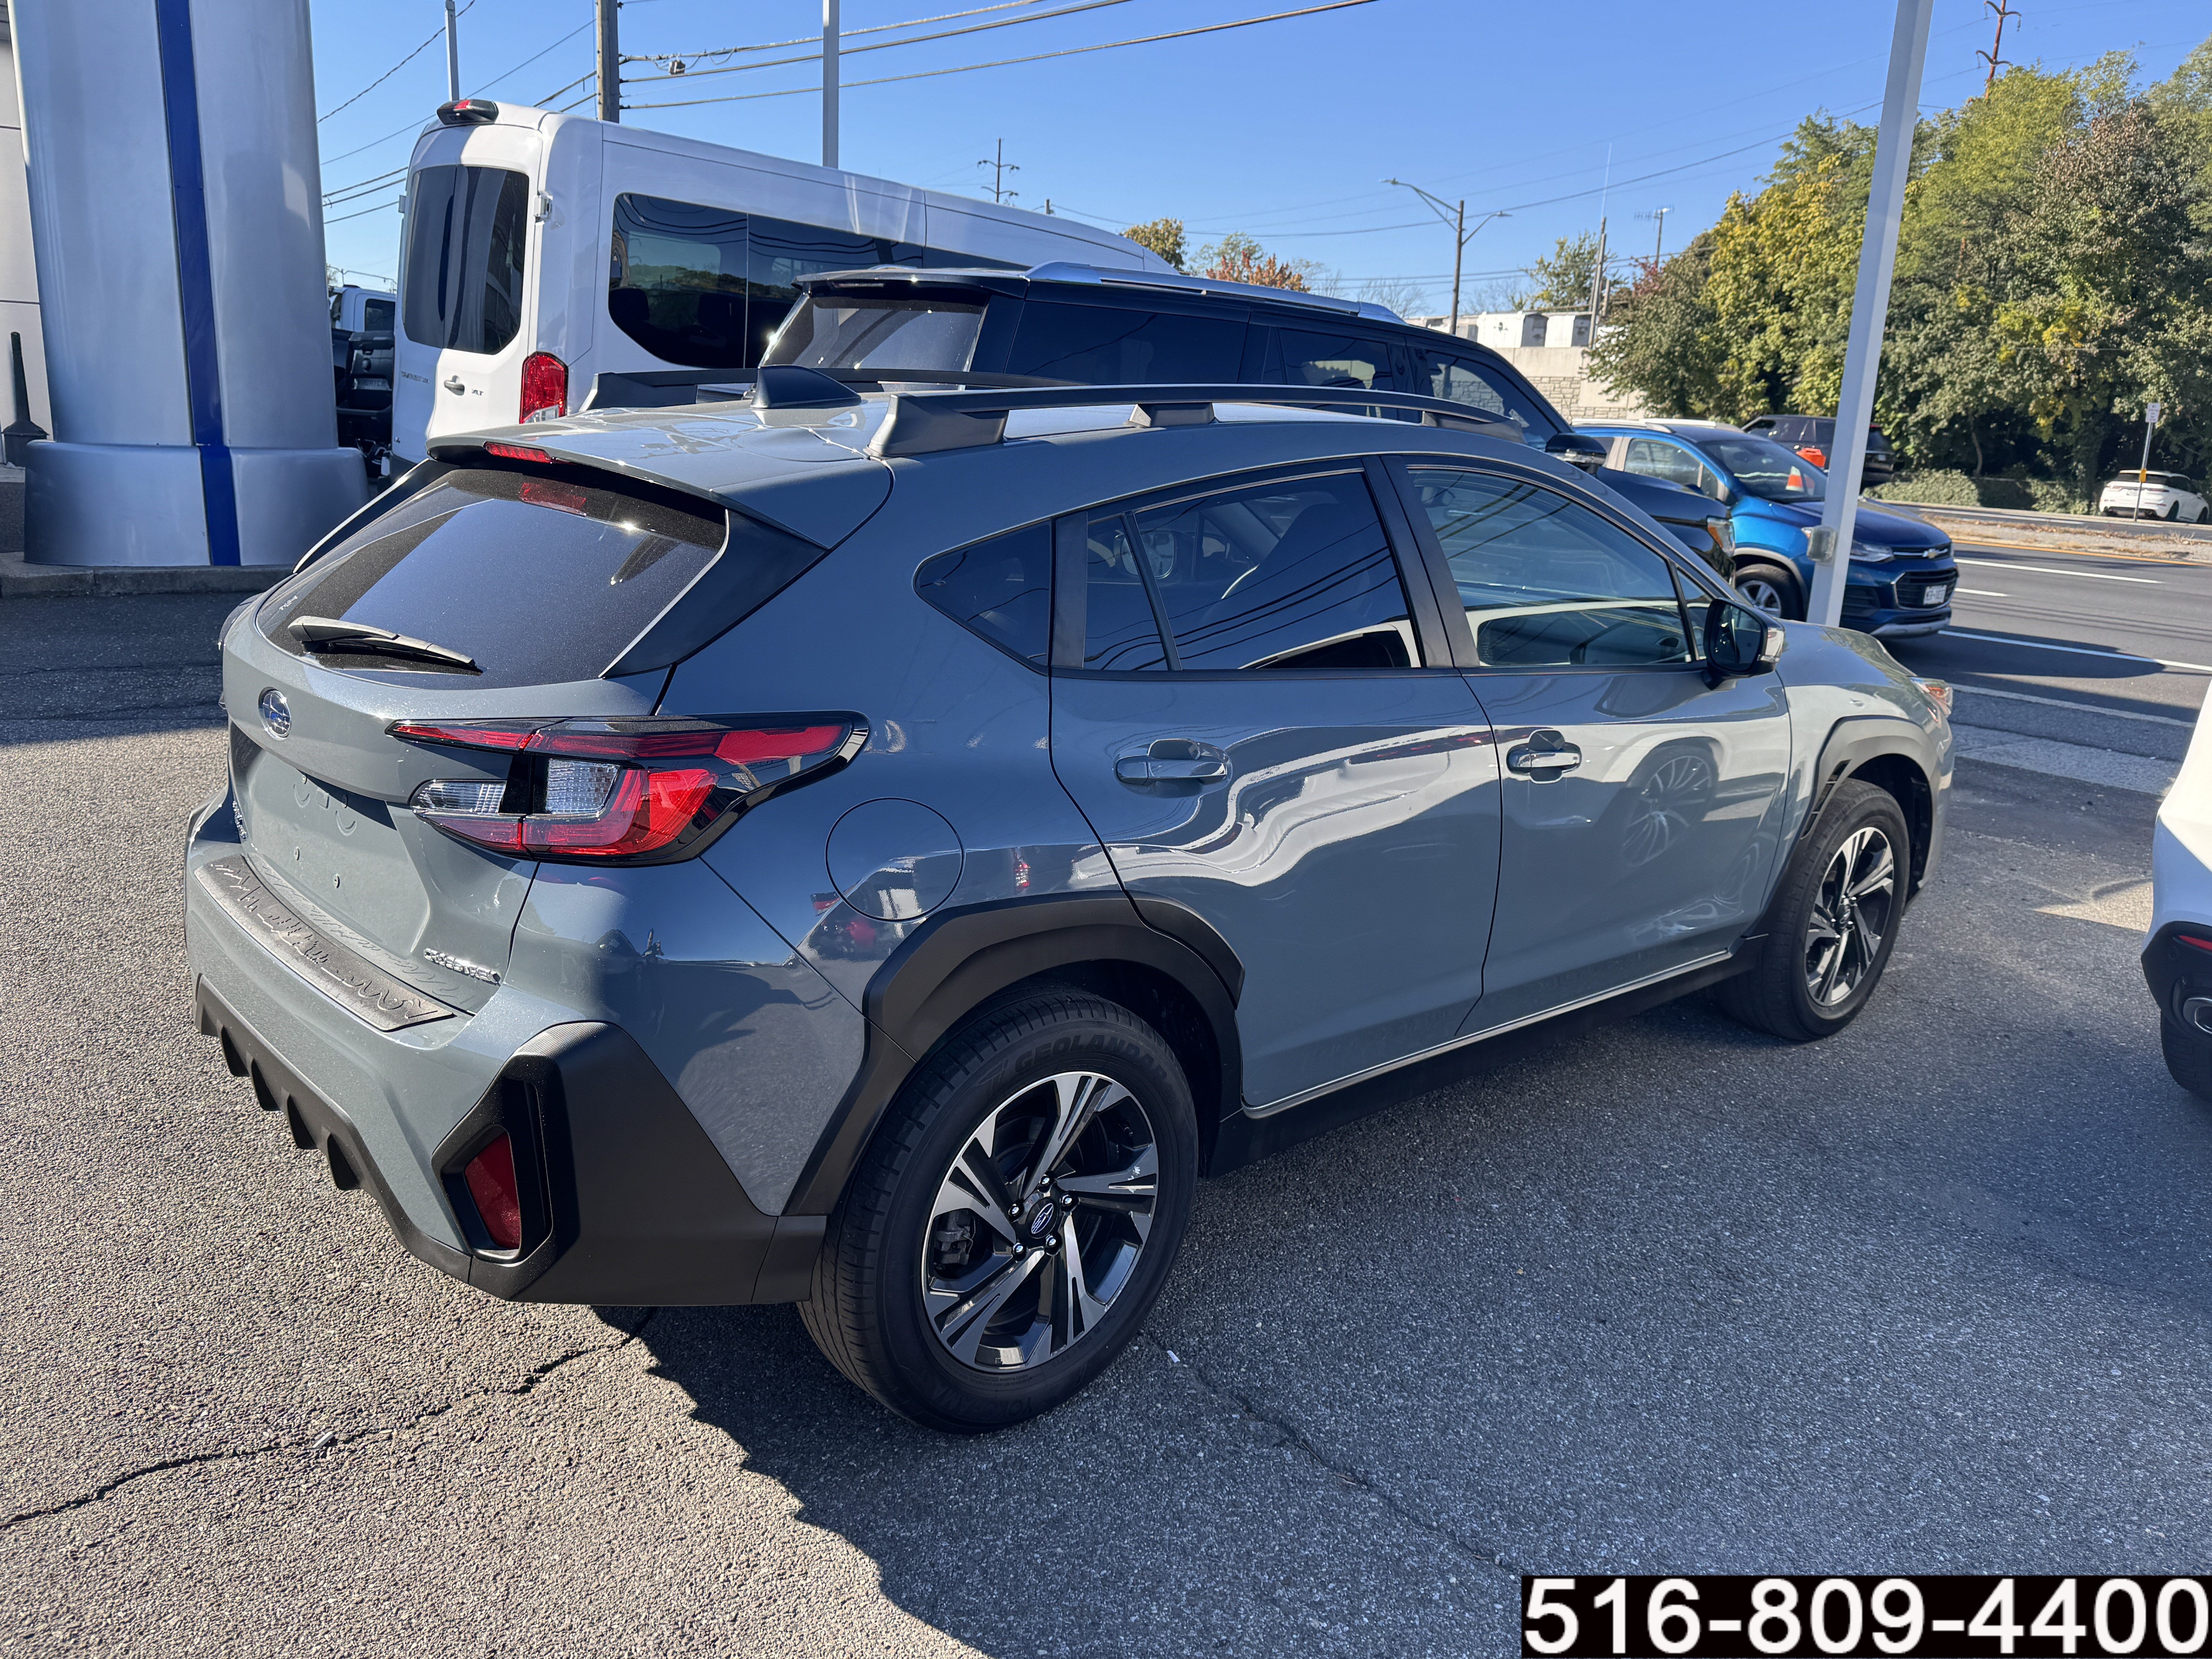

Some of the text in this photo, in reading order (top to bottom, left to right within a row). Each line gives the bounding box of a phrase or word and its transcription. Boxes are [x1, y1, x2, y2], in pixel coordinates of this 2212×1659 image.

[423, 948, 501, 984] CROSSTREK
[1015, 1034, 1168, 1079] GEOLANDAR
[931, 1383, 1032, 1419] YOKOAMA
